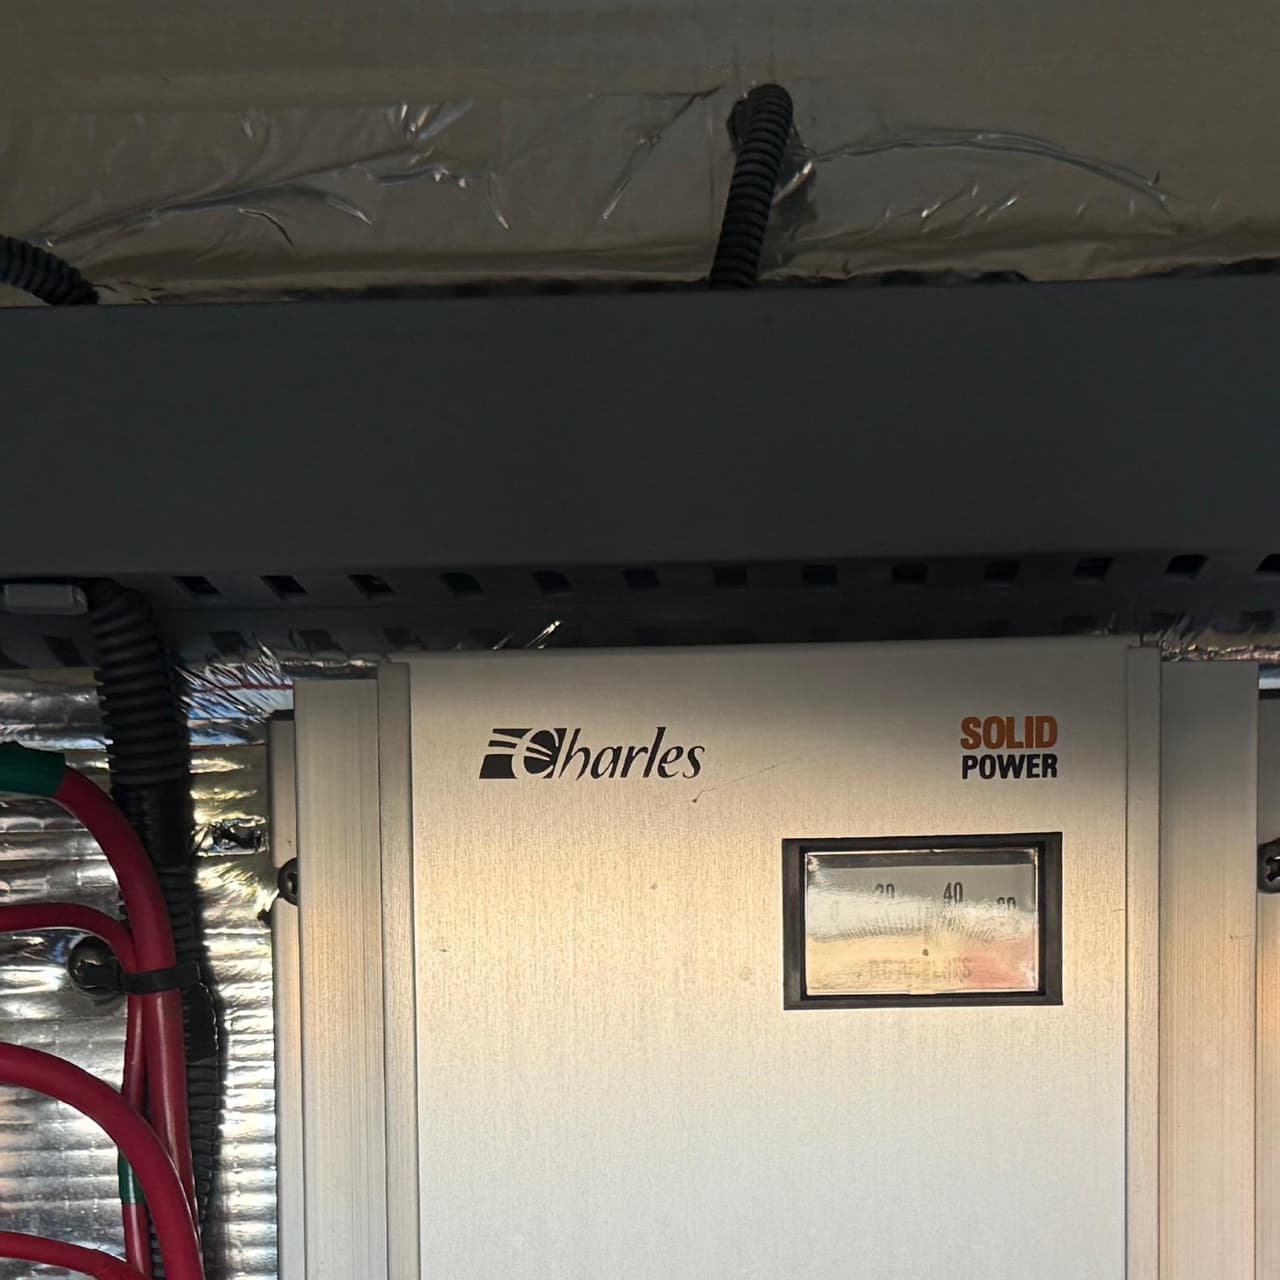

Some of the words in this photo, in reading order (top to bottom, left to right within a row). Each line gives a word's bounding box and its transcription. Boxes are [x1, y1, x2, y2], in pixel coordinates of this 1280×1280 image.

[959, 715, 1058, 750] SOLID
[505, 726, 705, 781] Charles
[961, 754, 1058, 780] POWER
[943, 881, 963, 904] 40
